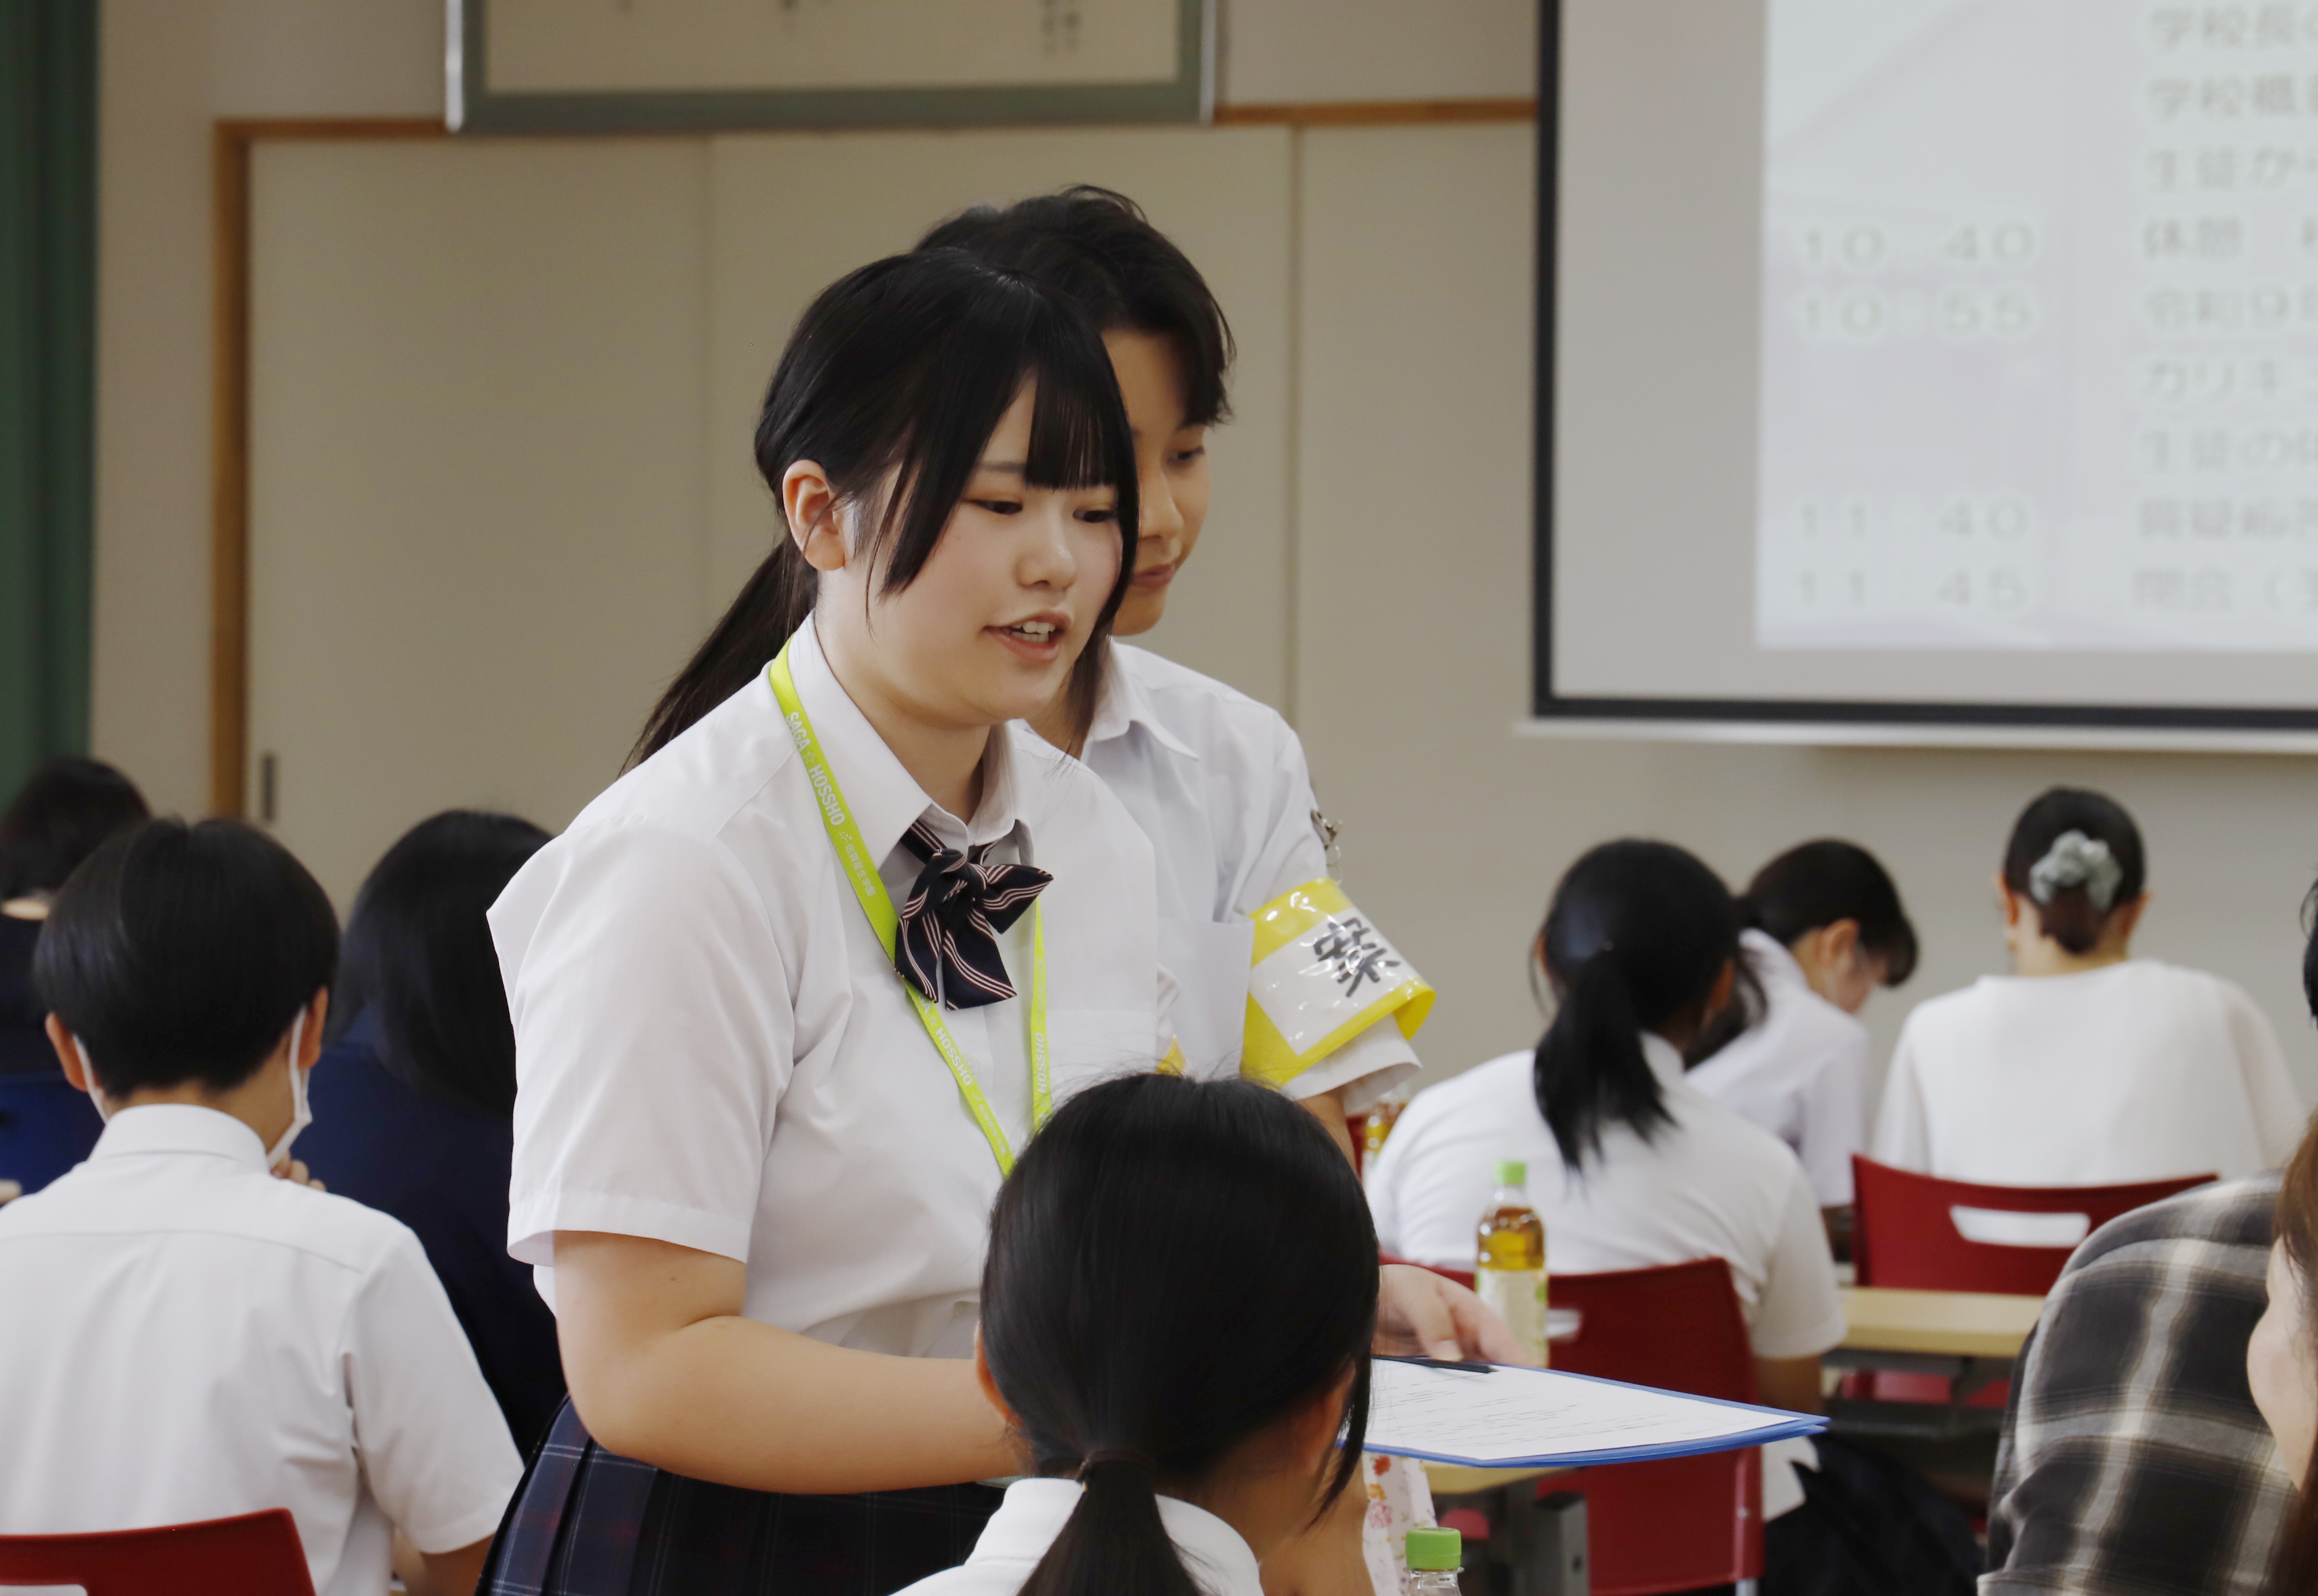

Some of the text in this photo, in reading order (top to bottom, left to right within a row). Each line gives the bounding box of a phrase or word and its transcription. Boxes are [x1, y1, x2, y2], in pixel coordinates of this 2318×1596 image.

[786, 711, 811, 753] SAGA
[808, 763, 846, 826] HOSSHO
[1313, 917, 1401, 998] 案
[935, 1027, 972, 1086] HOSSHO
[1036, 1031, 1048, 1095] HOSSHO
